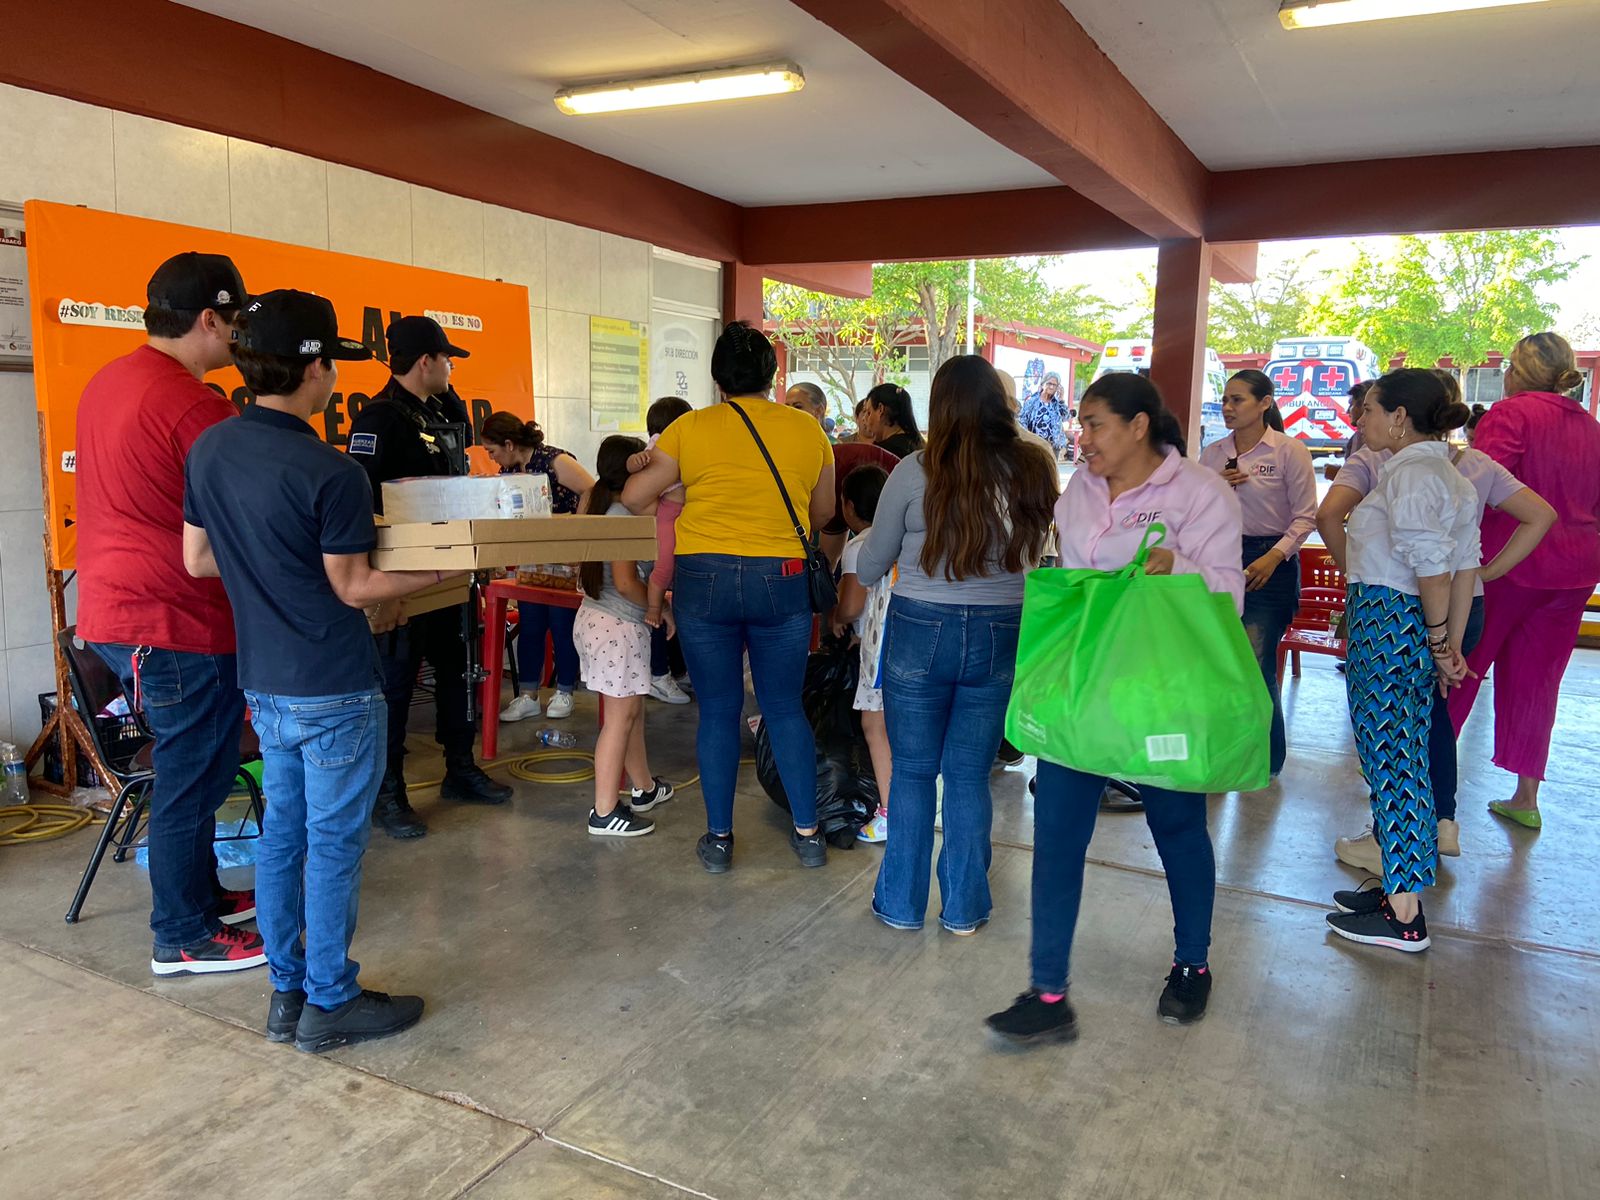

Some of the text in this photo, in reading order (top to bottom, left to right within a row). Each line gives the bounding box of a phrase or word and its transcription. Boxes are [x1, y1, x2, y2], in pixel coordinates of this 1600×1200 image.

[60, 304, 98, 318] #SOY
[452, 315, 464, 326] ES
[467, 317, 480, 329] NO
[1259, 465, 1275, 473] DIF
[1137, 511, 1162, 522] DIF
